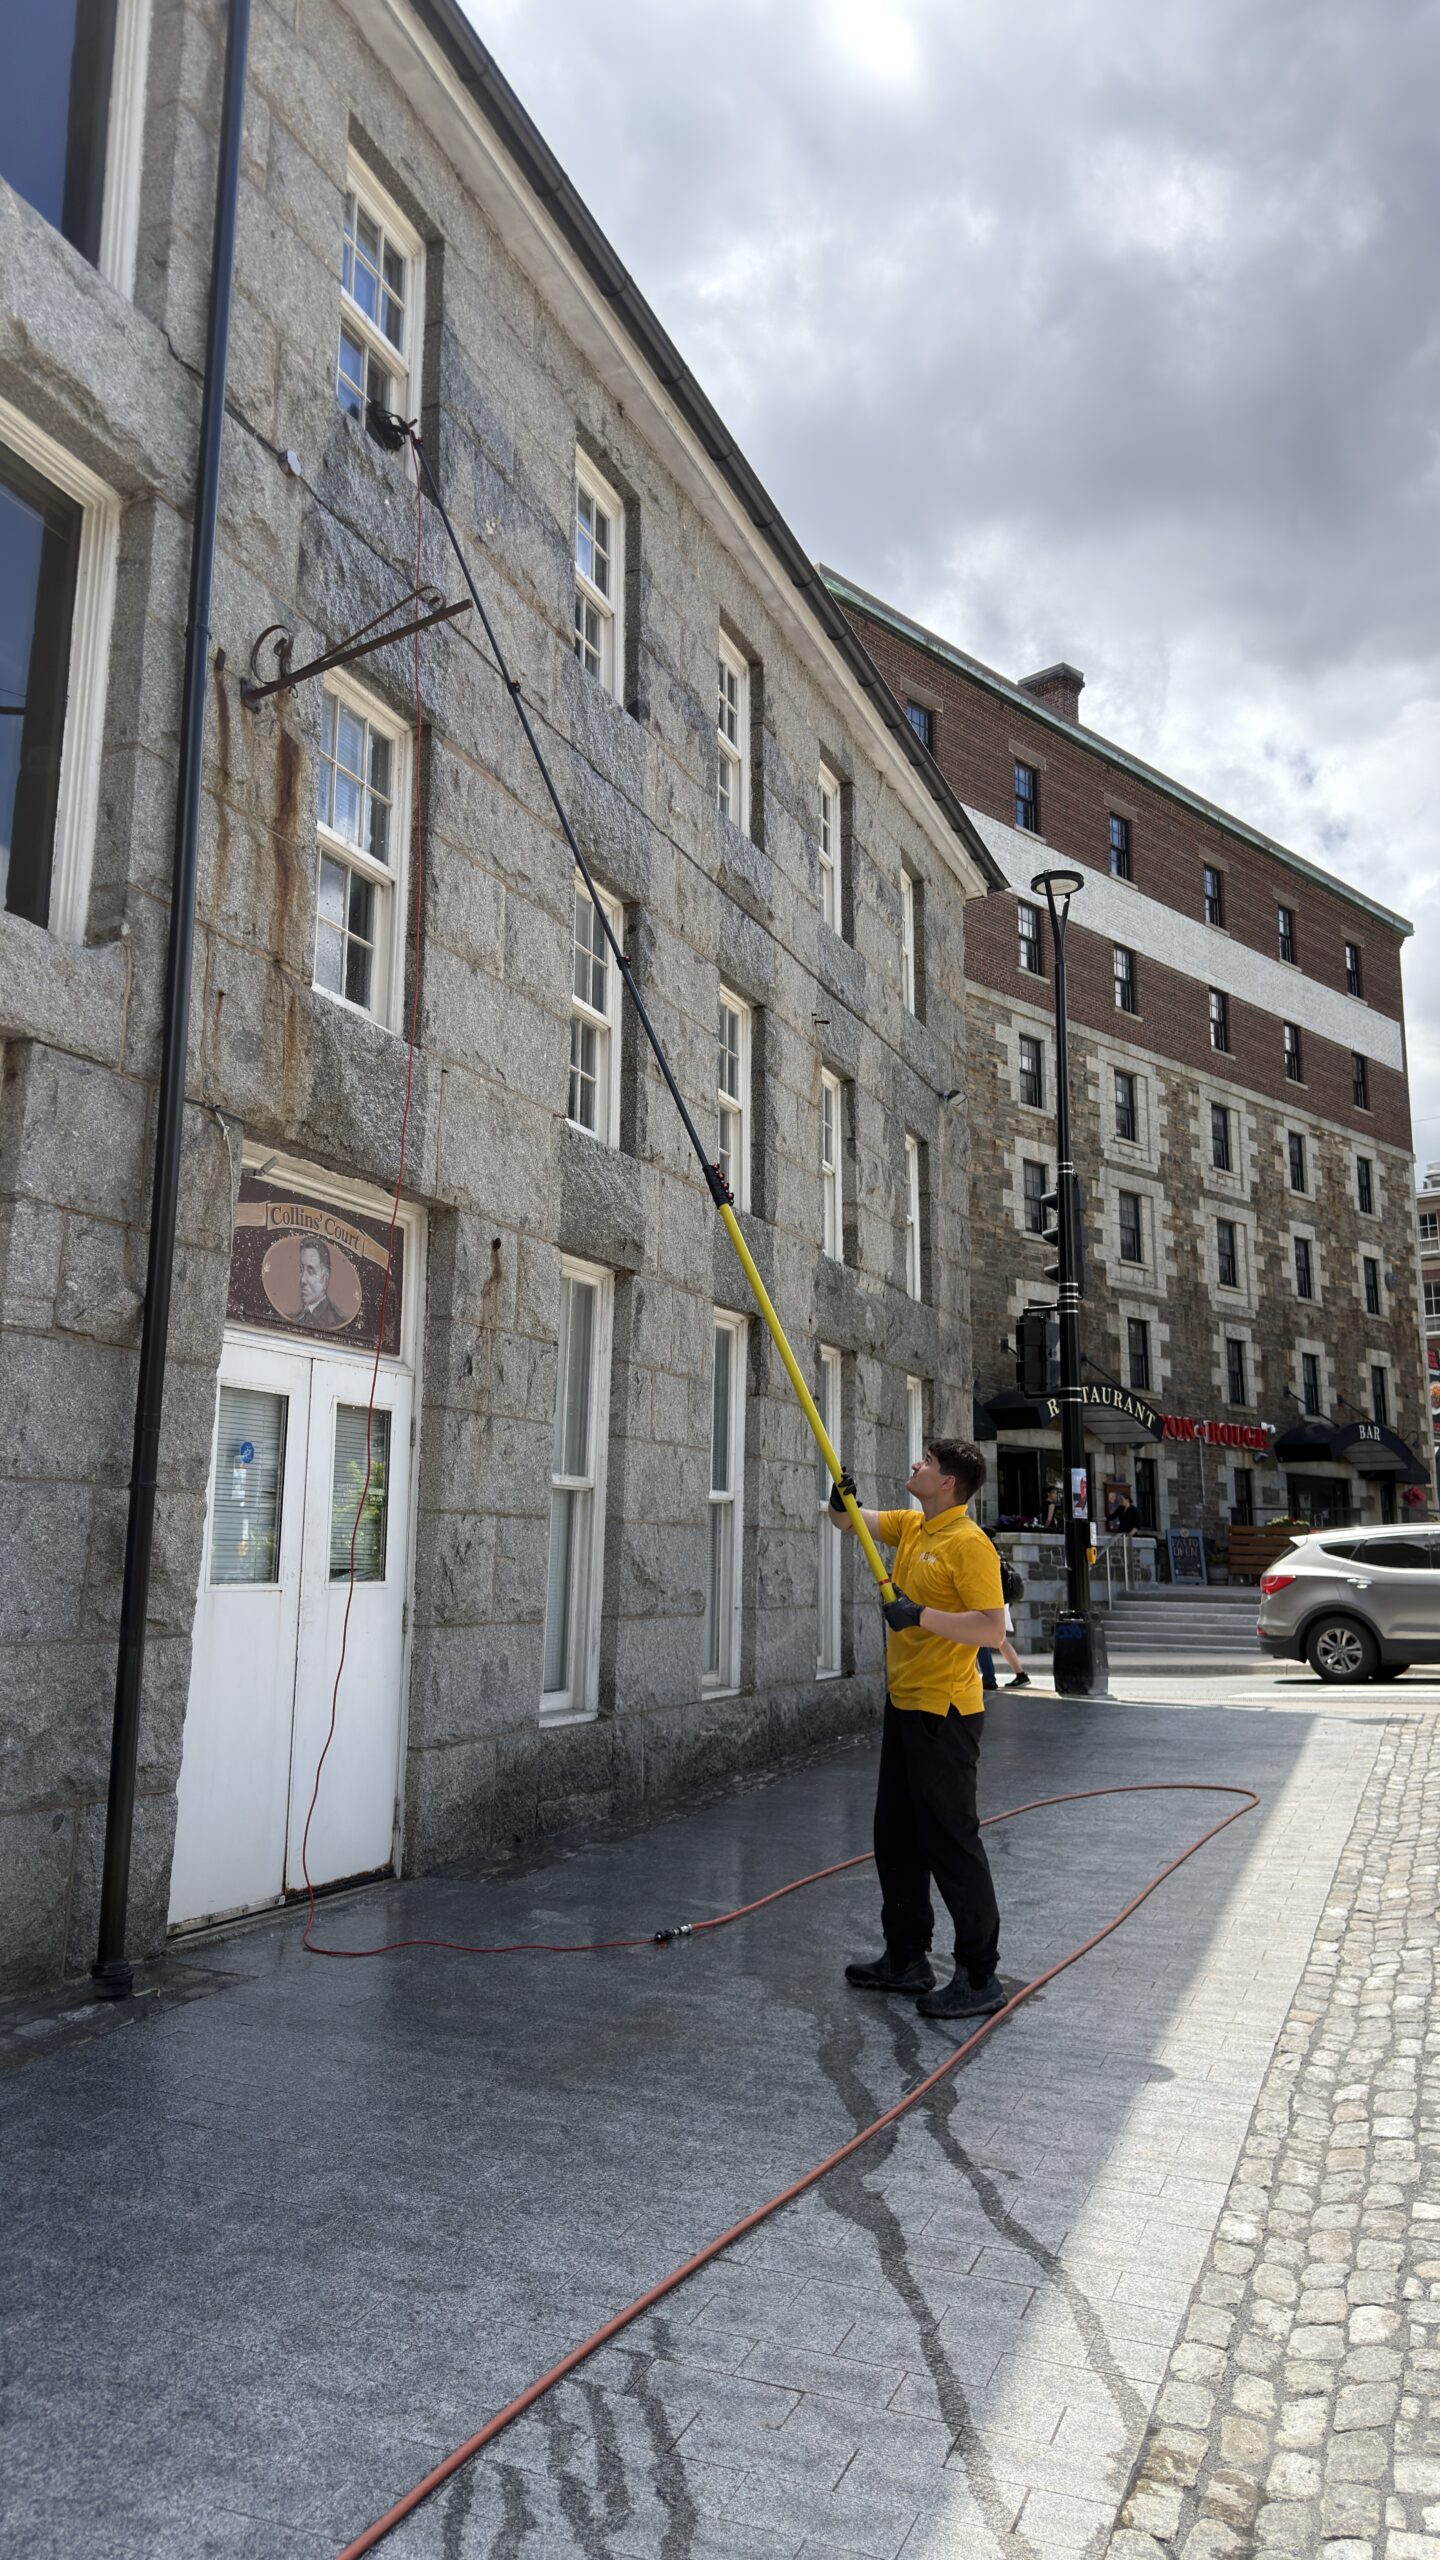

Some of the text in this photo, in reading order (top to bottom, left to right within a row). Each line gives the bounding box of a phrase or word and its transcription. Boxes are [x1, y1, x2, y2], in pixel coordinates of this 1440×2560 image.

[270, 1206, 360, 1250] Collins' Court
[1046, 1386, 1156, 1430] RTAURANT
[1203, 1420, 1270, 1450] ROUGE
[1359, 1424, 1380, 1441] BAR
